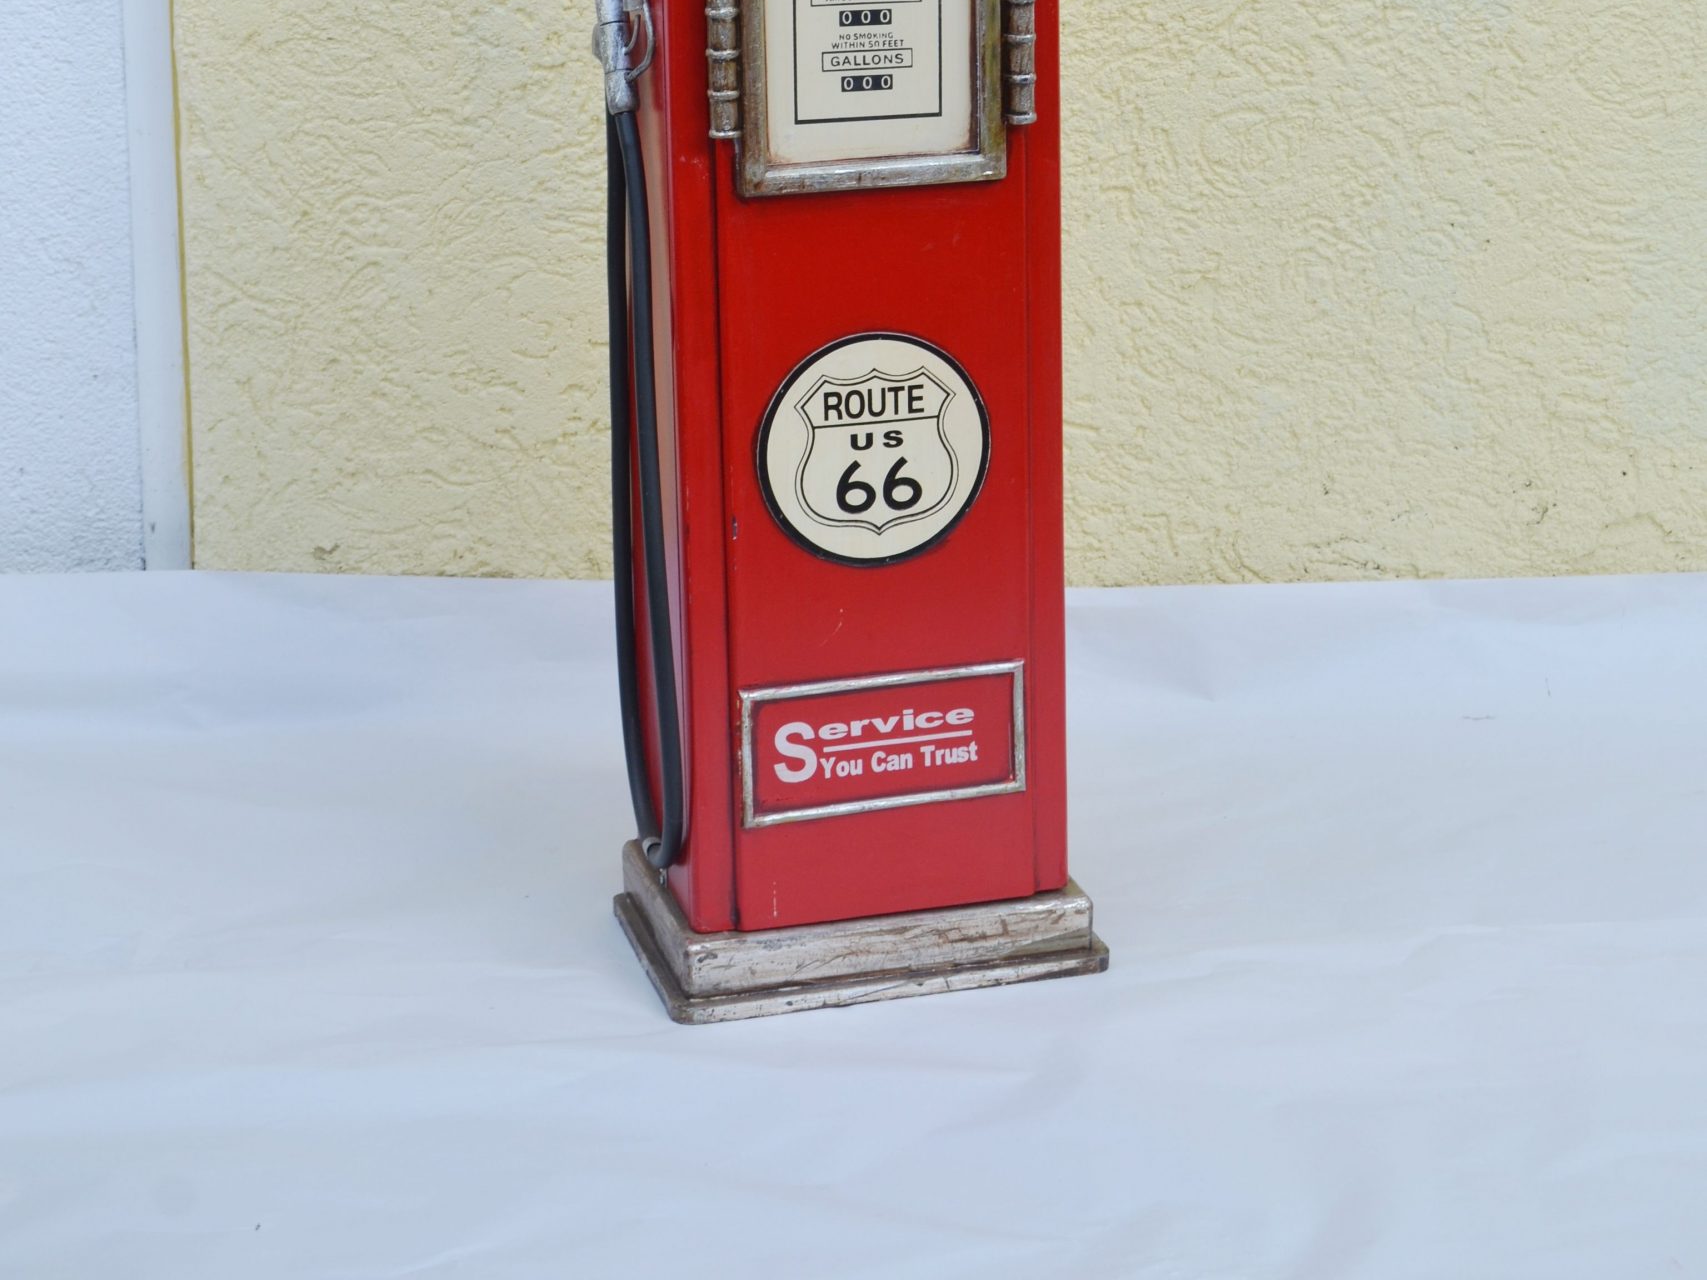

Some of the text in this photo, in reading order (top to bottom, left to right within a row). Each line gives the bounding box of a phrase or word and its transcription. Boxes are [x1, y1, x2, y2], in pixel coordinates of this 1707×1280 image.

[831, 41, 866, 49] WITHIN
[882, 39, 905, 47] FEET
[853, 32, 894, 40] SMOKING
[830, 53, 904, 67] GALLONS
[823, 384, 925, 421] ROUTE
[850, 430, 904, 451] US
[836, 456, 923, 515] 66
[774, 707, 975, 784] Service
[819, 740, 979, 779] You Can Trust
